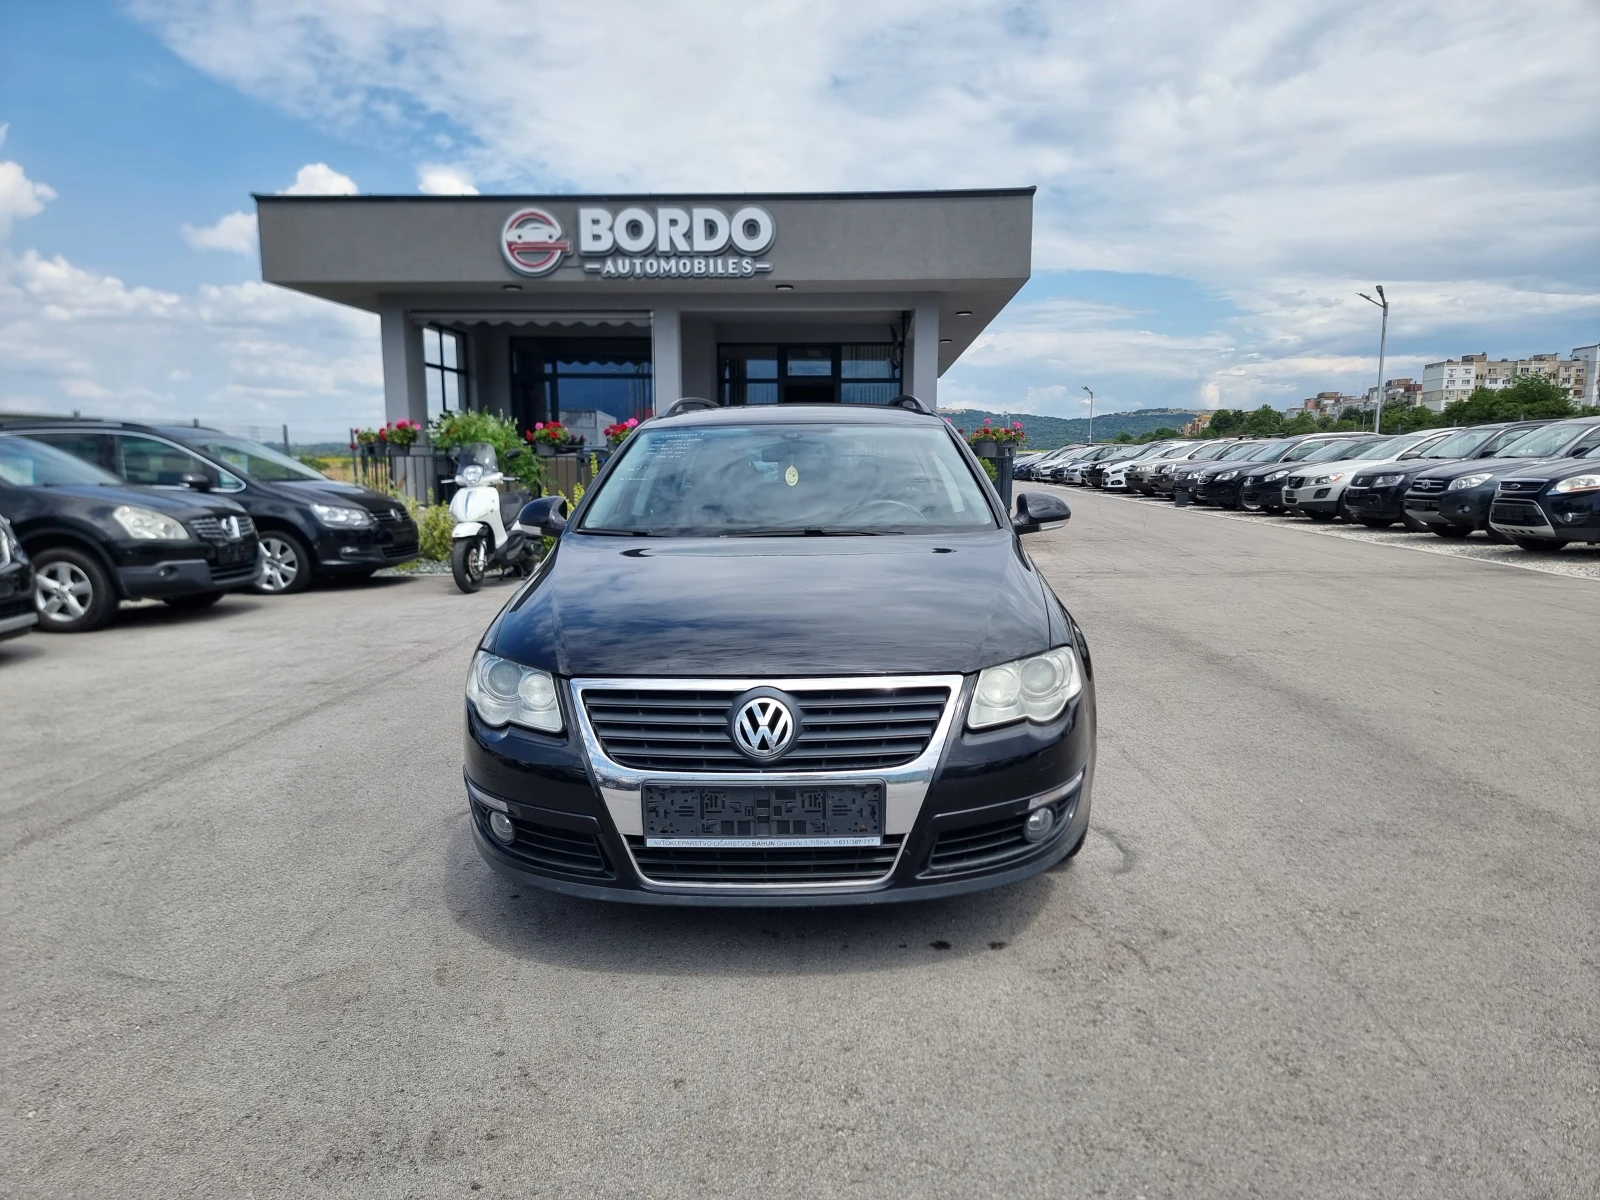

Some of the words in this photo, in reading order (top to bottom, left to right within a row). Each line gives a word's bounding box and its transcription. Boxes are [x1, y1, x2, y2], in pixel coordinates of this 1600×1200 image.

[579, 207, 773, 252] BORDO
[603, 259, 753, 275] AUTOMOBILES
[736, 697, 793, 755] VW
